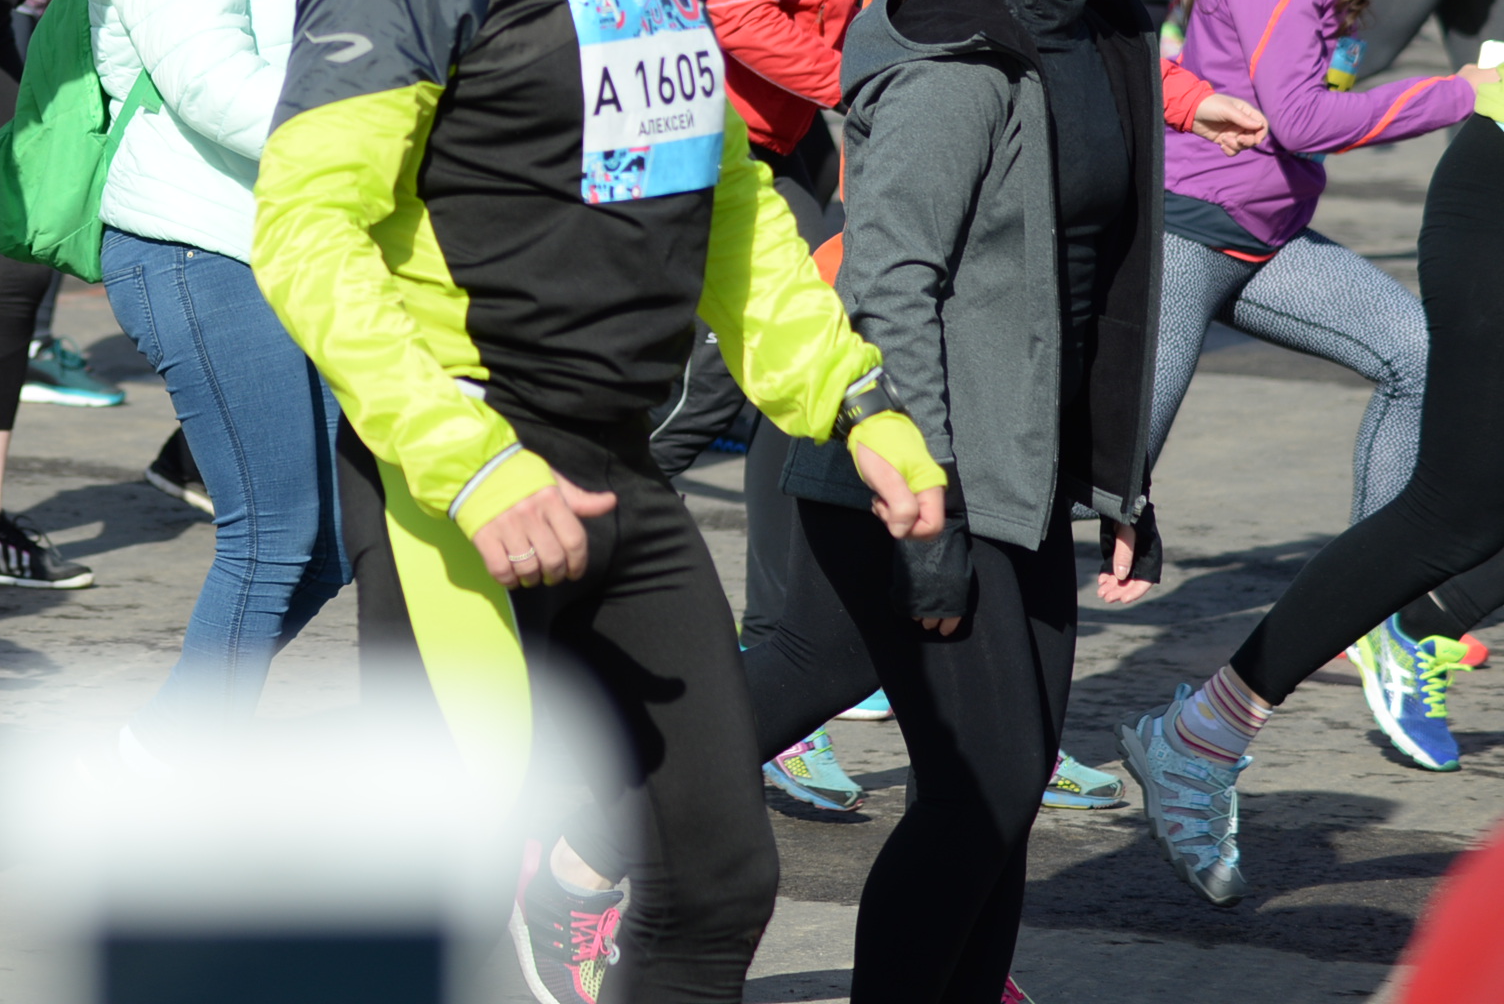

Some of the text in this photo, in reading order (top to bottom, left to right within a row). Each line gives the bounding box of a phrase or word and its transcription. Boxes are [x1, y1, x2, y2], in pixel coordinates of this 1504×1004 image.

[593, 50, 715, 117] A 1605
[637, 108, 695, 137] АЛЕКСЕЙ
